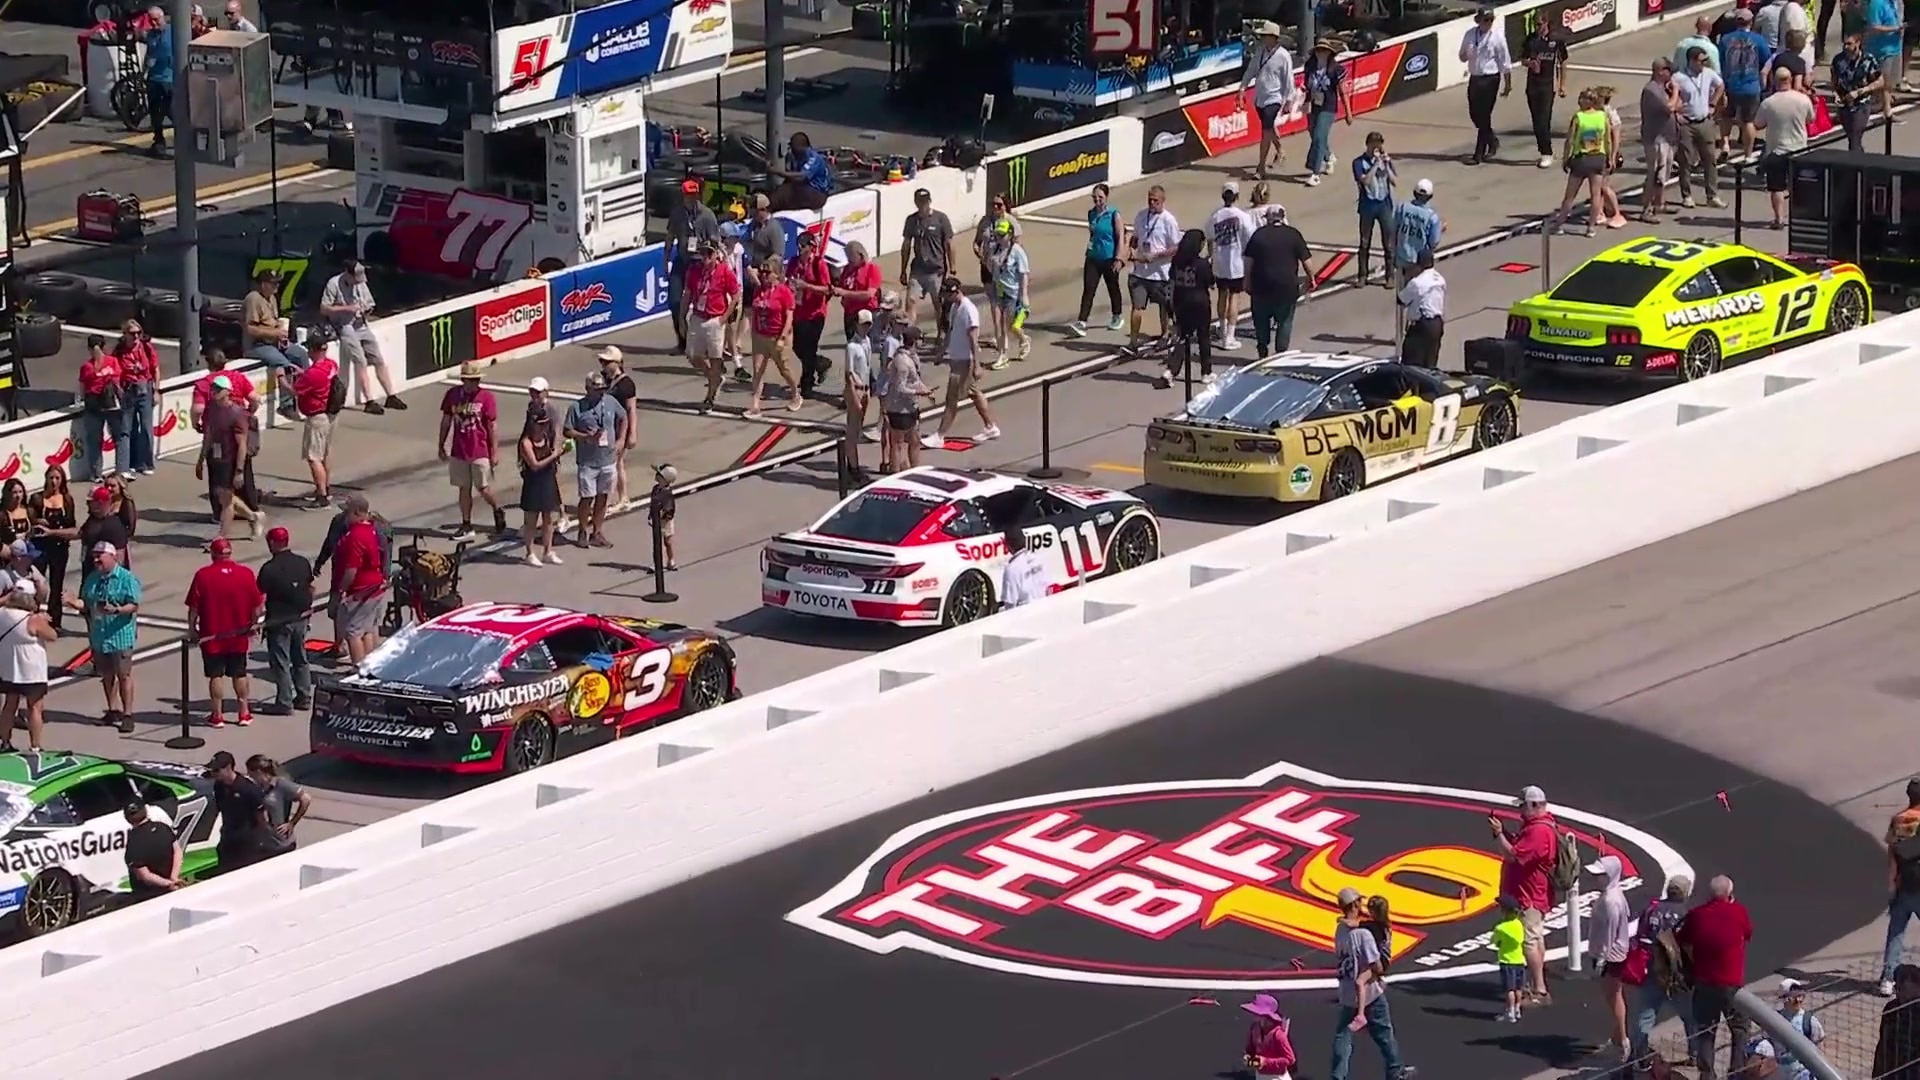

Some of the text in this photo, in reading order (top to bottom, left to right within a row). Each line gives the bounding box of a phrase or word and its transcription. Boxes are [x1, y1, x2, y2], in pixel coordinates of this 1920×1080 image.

[1092, 0, 1153, 49] 51
[1563, 0, 1613, 24] SportClips
[601, 38, 650, 58] CONSTRUCTION
[511, 34, 553, 95] 51
[1049, 152, 1108, 178] GOODYEAR
[440, 188, 532, 272] 77
[480, 302, 543, 332] SportClips
[1663, 290, 1766, 329] MENARDS
[1773, 284, 1819, 338] 12
[1540, 326, 1593, 340] MENARDS
[1556, 353, 1605, 364] RACING
[1614, 354, 1634, 366] 12
[1650, 352, 1678, 368] DELTA
[1424, 393, 1462, 455] 8
[955, 530, 1054, 563] Sportips
[1060, 519, 1104, 579] 11
[802, 563, 850, 579] SportClips
[794, 590, 848, 611] TOYOTA
[871, 580, 889, 594] 11
[459, 674, 570, 714] WINCHESTER
[623, 647, 673, 712] 3
[326, 713, 436, 740] WINCHESTER
[336, 732, 410, 749] CHEVROLET
[443, 721, 459, 735] 3
[173, 796, 208, 852] 7
[0, 830, 130, 874] NationsGua
[1063, 790, 1350, 934] BIFF
[852, 811, 1148, 937] THE
[1202, 842, 1504, 963] 16
[1414, 952, 1451, 967] IN
